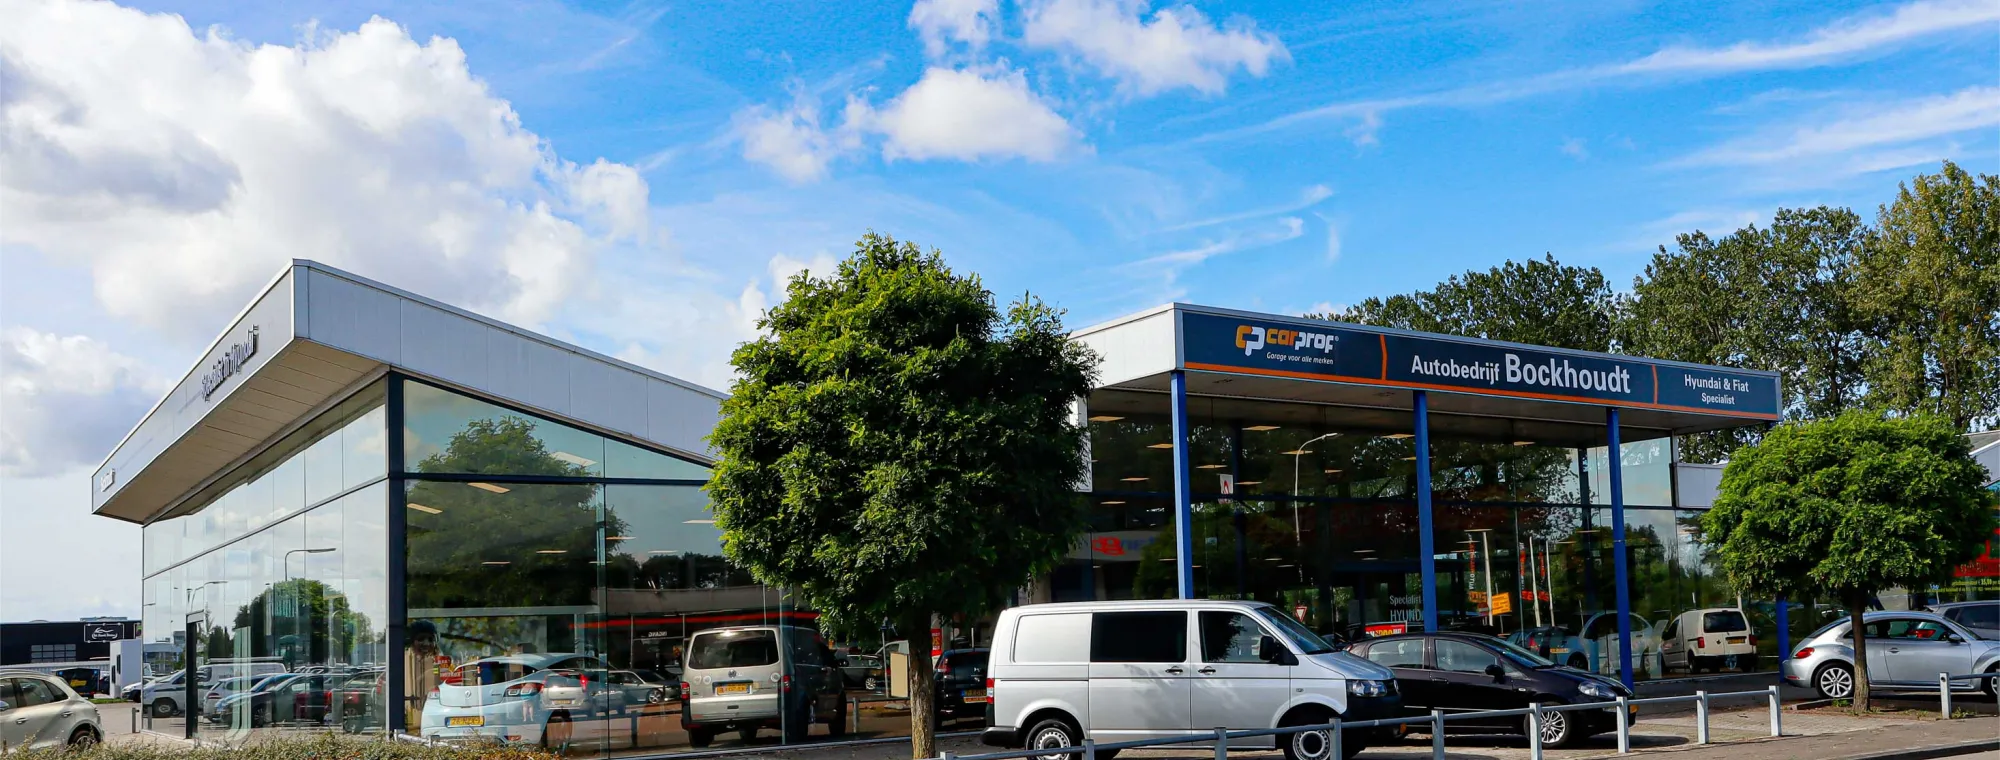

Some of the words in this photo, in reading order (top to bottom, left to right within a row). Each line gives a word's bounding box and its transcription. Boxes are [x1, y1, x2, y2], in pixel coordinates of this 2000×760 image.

[1266, 328, 1334, 353] carprof
[1266, 351, 1287, 361] Garage
[1287, 354, 1300, 362] voor
[1301, 355, 1312, 363] alle
[1313, 357, 1334, 365] merken
[1411, 355, 1499, 385] Autobedrijf
[1505, 353, 1631, 394] Bockhoudt
[1684, 374, 1721, 390] Hyundai
[1723, 378, 1731, 390] &
[1732, 379, 1749, 392] Fiat
[1701, 392, 1735, 405] Specialist
[1389, 594, 1422, 606] Specialist
[1390, 609, 1424, 622] HYUND
